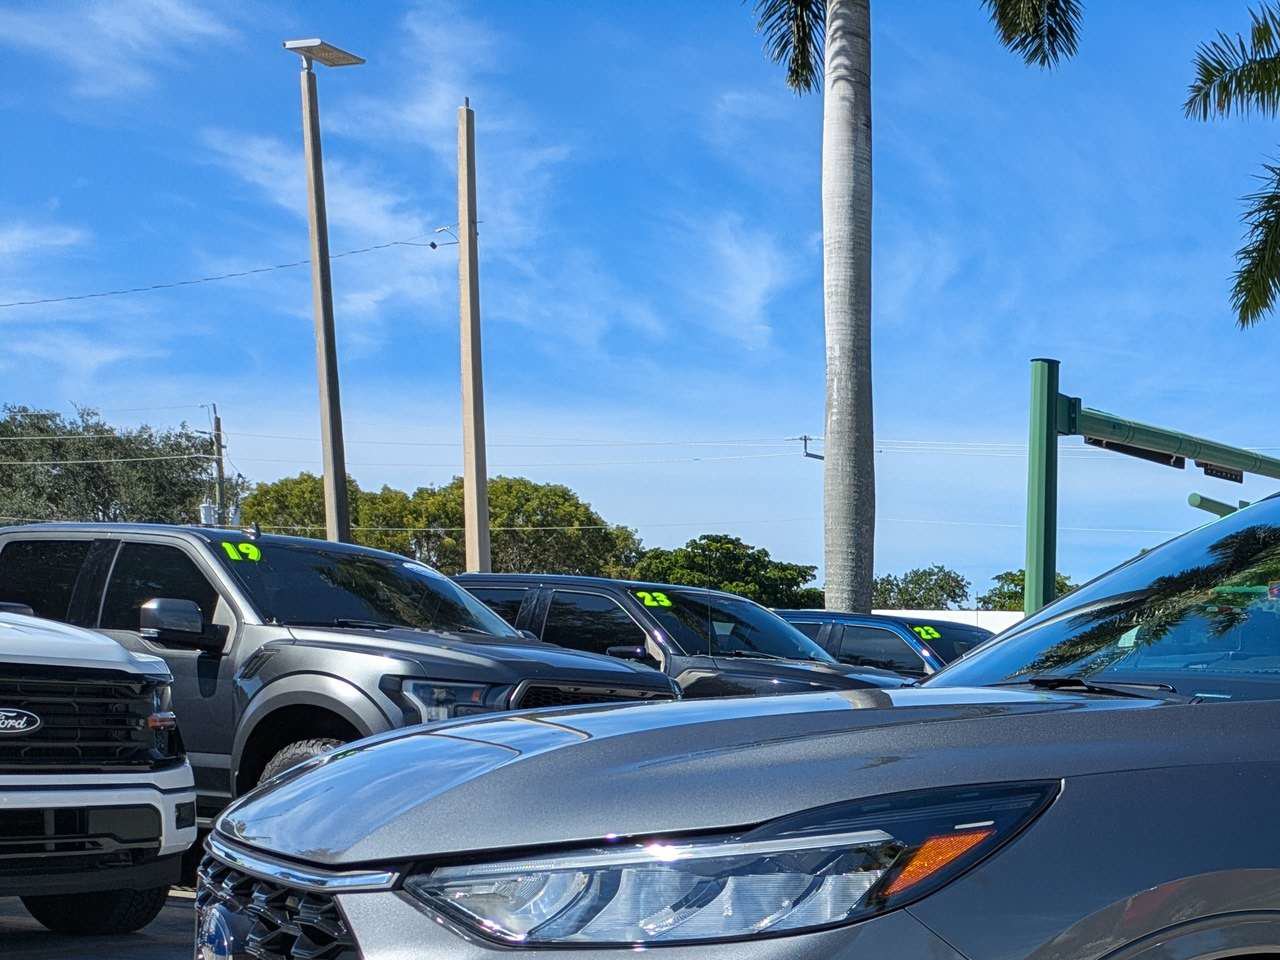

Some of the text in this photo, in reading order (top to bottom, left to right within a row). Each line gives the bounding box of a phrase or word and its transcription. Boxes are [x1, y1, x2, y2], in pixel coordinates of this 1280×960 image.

[221, 541, 262, 561] 19
[636, 591, 672, 608] 23
[913, 625, 941, 640] 23
